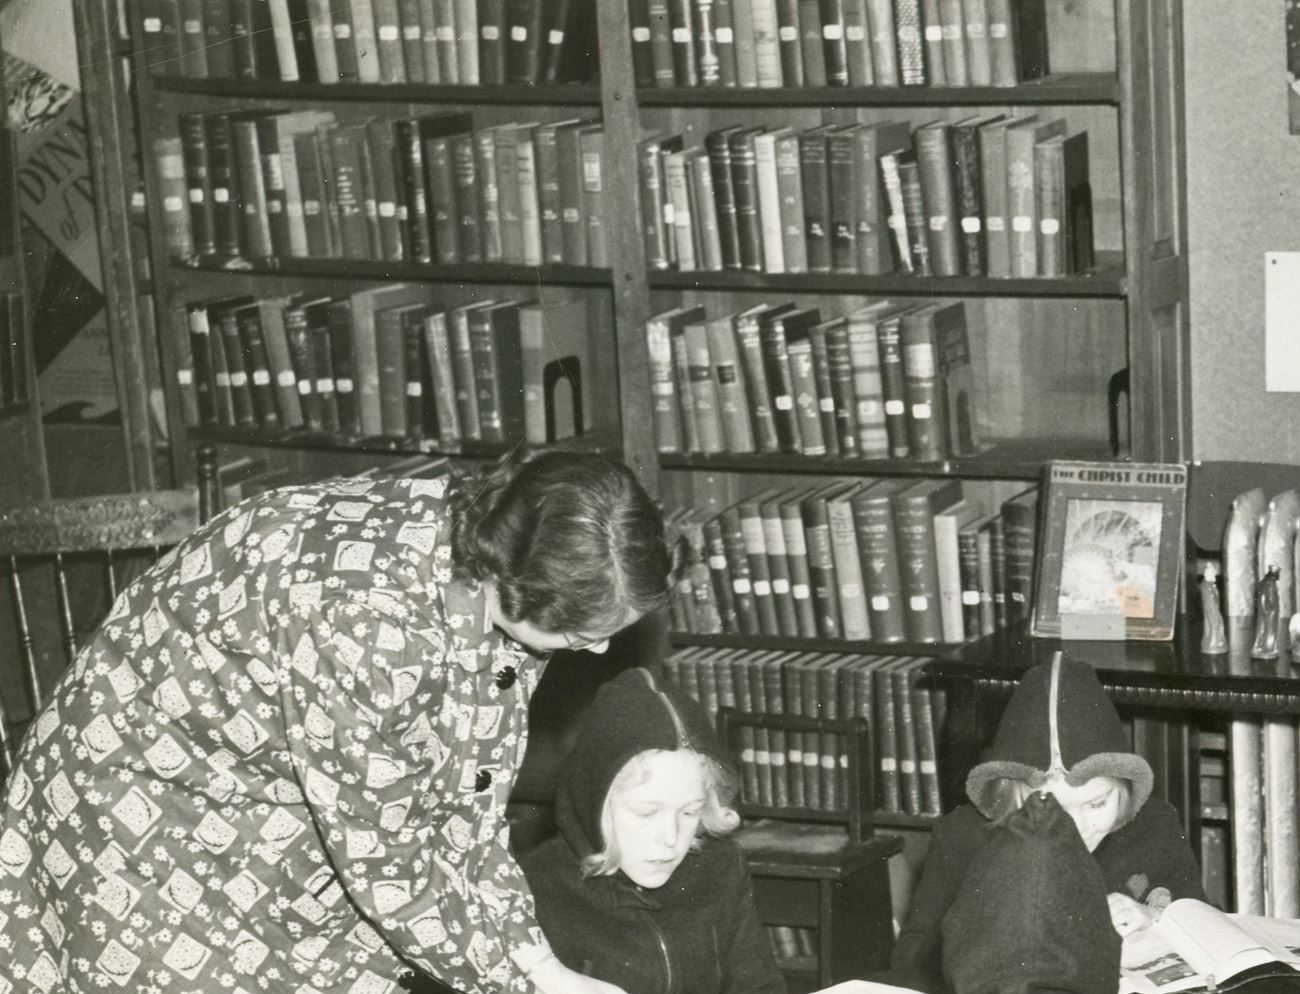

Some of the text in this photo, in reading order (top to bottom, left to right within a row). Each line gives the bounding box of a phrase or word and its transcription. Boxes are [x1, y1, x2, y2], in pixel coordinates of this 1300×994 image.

[1052, 469, 1186, 485] THE CHRIST CHILD
